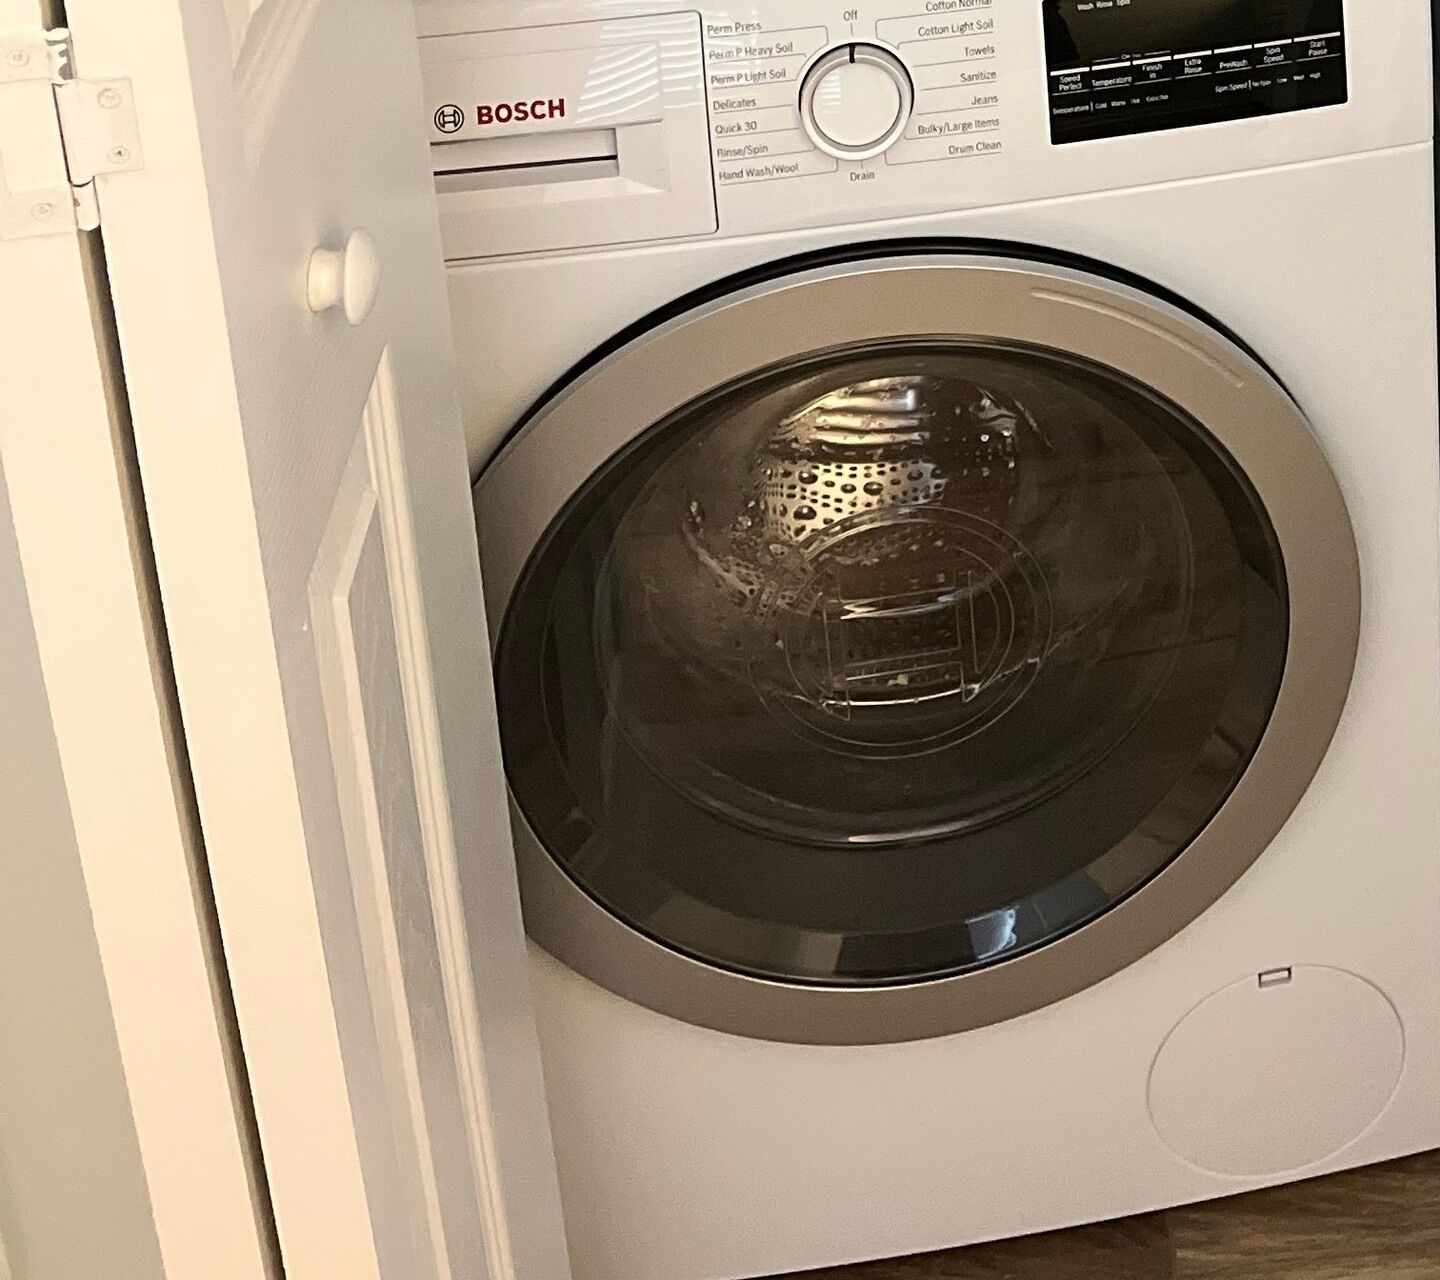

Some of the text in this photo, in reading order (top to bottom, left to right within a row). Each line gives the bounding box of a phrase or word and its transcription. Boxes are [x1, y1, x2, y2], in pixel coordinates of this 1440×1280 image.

[925, 0, 957, 12] Cotton
[843, 9, 858, 22] Off
[707, 21, 762, 35] Perm Press
[918, 19, 994, 37] Cotton Light Soil
[709, 42, 794, 61] Perm P Heavy Soil
[964, 45, 995, 57] Towels
[1263, 54, 1285, 64] Speed
[711, 68, 786, 86] Perm P Light Soil
[960, 70, 997, 82] Sanitize
[1060, 74, 1081, 84] Speed
[1092, 76, 1132, 87] Temperature
[1058, 82, 1082, 92] Perfect
[713, 98, 757, 111] Delicates
[971, 95, 999, 106] Jeans
[476, 98, 565, 125] BOSCH
[715, 121, 757, 135] Quick 30
[918, 117, 1000, 135] Bulky/Large Items
[717, 144, 768, 158] Rinse/Spin
[948, 140, 1002, 155] Drum Clean
[719, 163, 799, 181] Hand Wash/Wool
[850, 170, 876, 182] Drain
